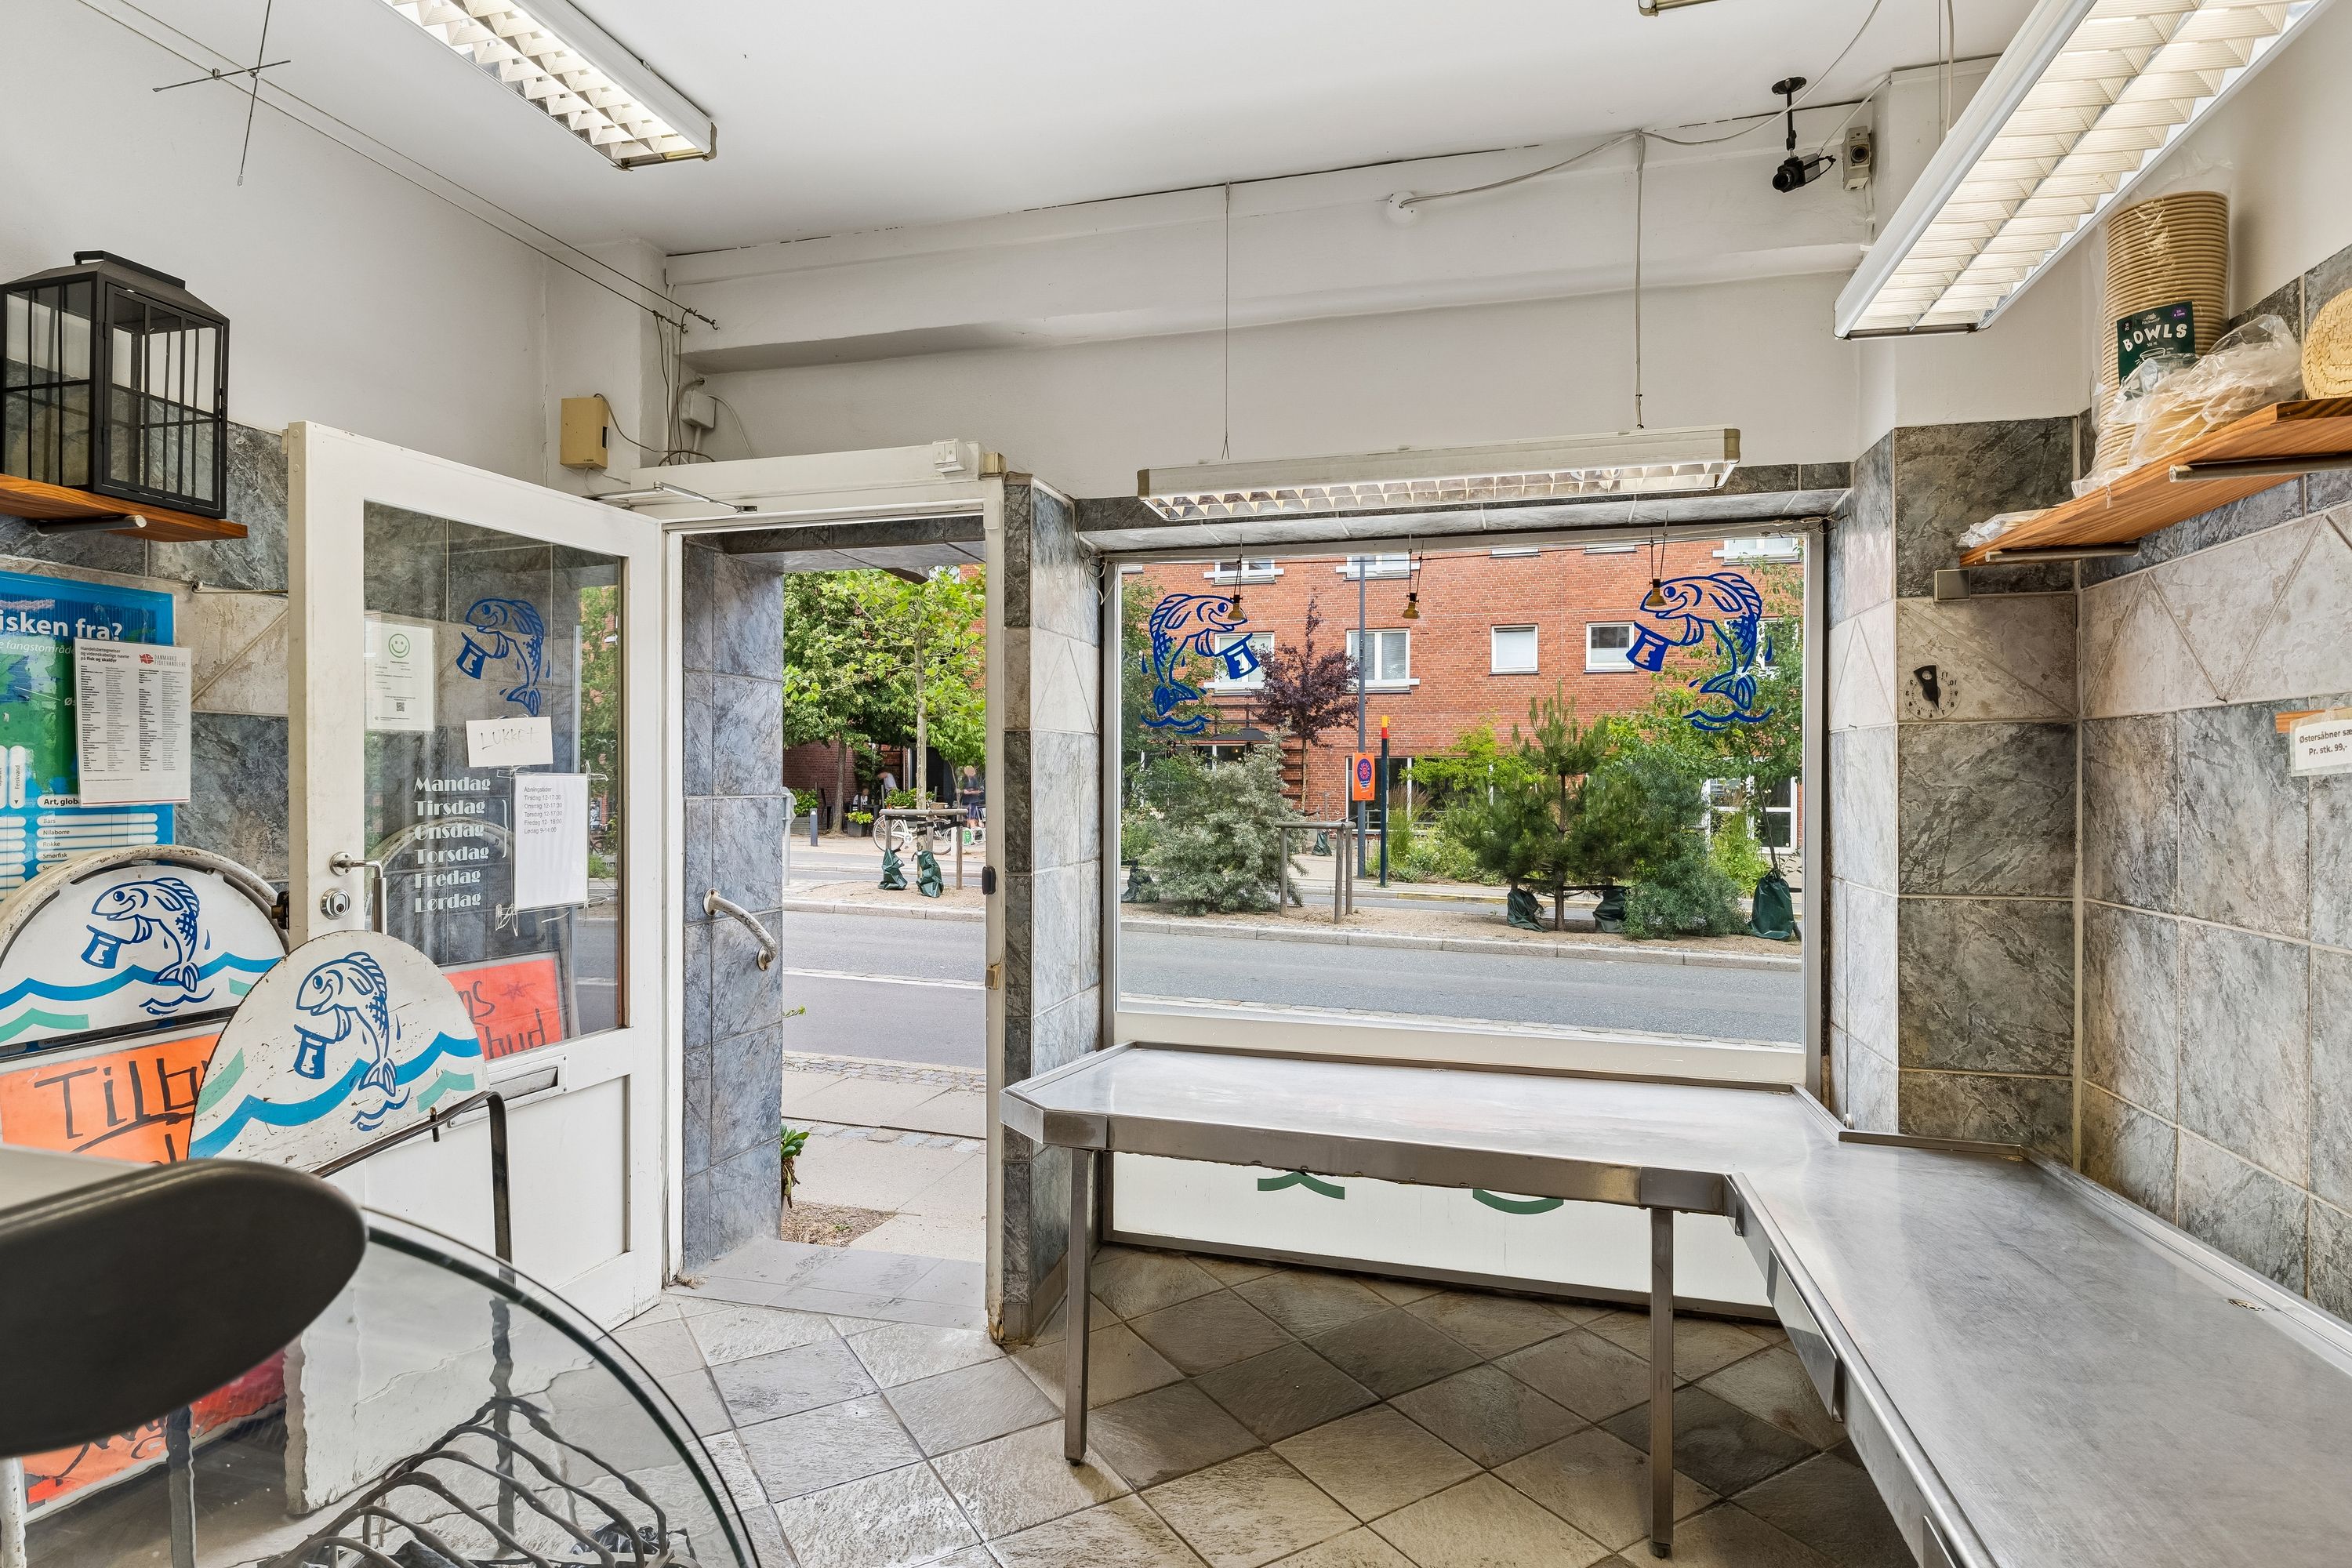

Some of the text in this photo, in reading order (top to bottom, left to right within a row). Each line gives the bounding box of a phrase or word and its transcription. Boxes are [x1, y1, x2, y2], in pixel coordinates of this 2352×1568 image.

[2122, 323, 2187, 352] BOWLS
[76, 618, 123, 641] fra?
[2299, 730, 2341, 744] Østersåbner
[2308, 742, 2348, 756] Pr. stk. 99,-
[414, 776, 492, 792] Mandag
[414, 800, 486, 816] Tirsdag
[414, 824, 485, 840] Onsdag
[414, 846, 490, 864] Torsdag
[415, 869, 482, 889] Fredag
[415, 892, 482, 913] Lørdag
[34, 1058, 208, 1139] Tilb
